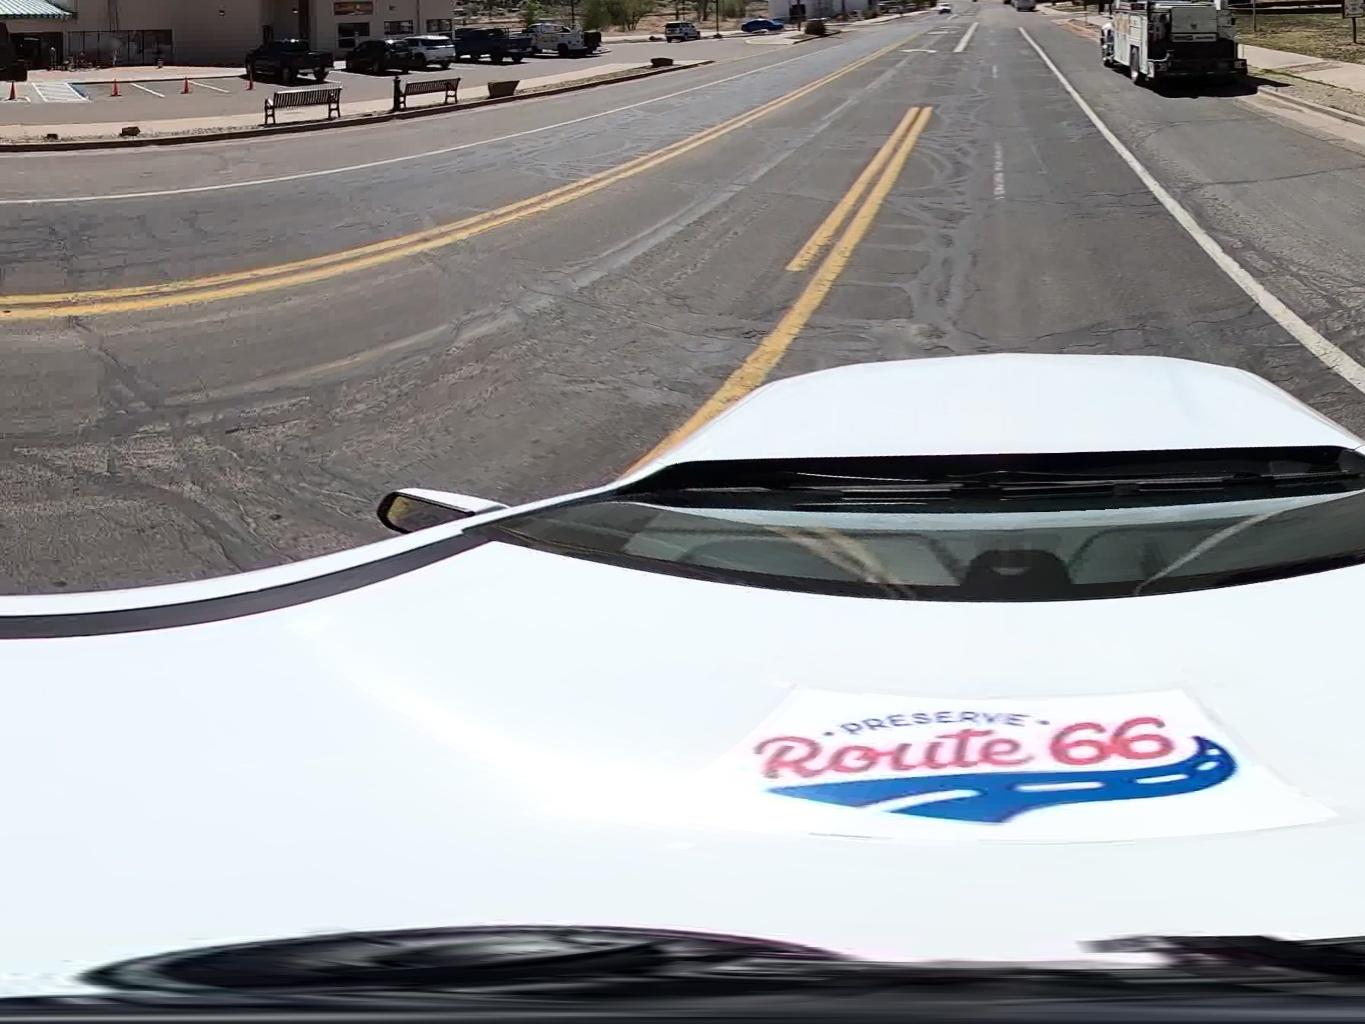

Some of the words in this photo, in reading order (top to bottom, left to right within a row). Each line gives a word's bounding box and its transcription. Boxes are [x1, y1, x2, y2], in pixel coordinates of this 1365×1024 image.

[840, 711, 1031, 735] PRESERVE
[754, 728, 1034, 779] Route
[1050, 716, 1175, 766] 66
